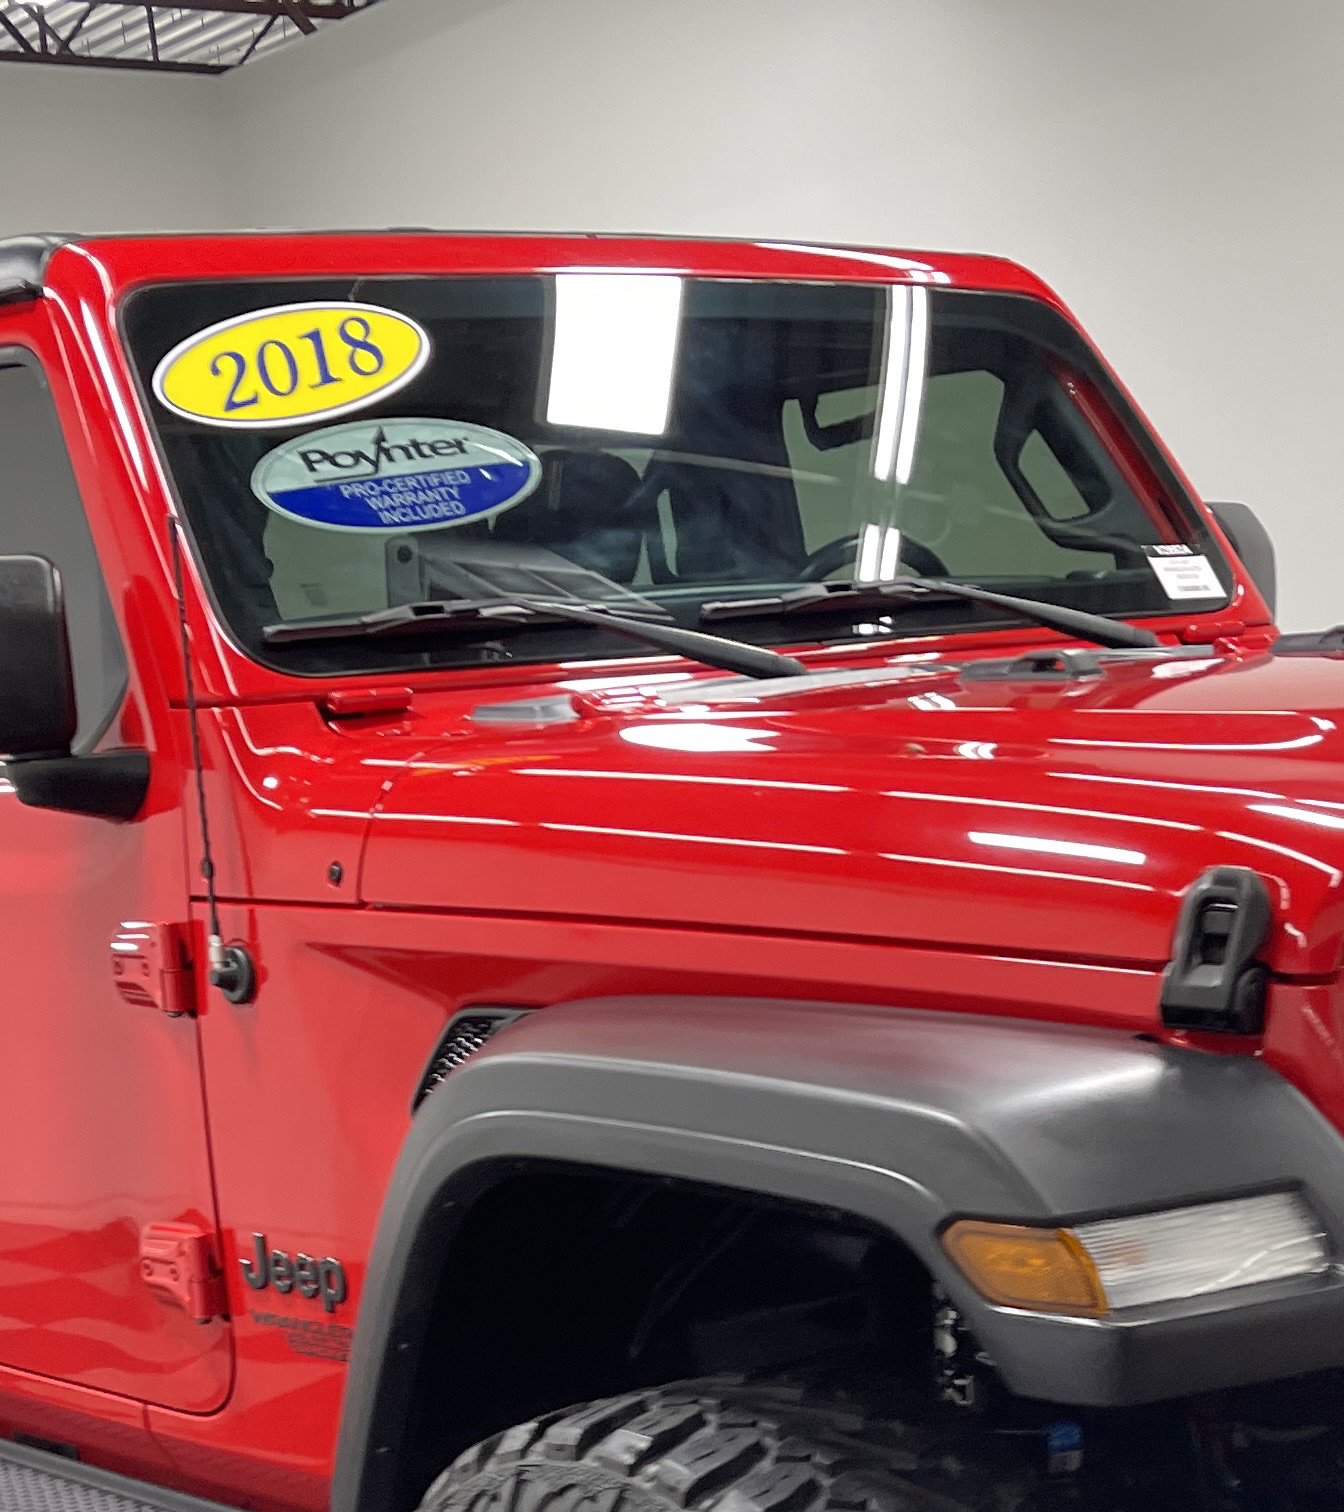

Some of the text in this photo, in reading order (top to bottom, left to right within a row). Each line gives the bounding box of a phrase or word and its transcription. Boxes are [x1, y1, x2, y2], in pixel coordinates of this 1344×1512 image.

[210, 317, 385, 411] 2018
[299, 426, 469, 477] Poynter
[339, 470, 471, 499] PRO-CERTIFIED
[365, 486, 460, 511] WARRANTY
[378, 501, 466, 525] INCLUDED
[238, 1231, 347, 1313] Jeep
